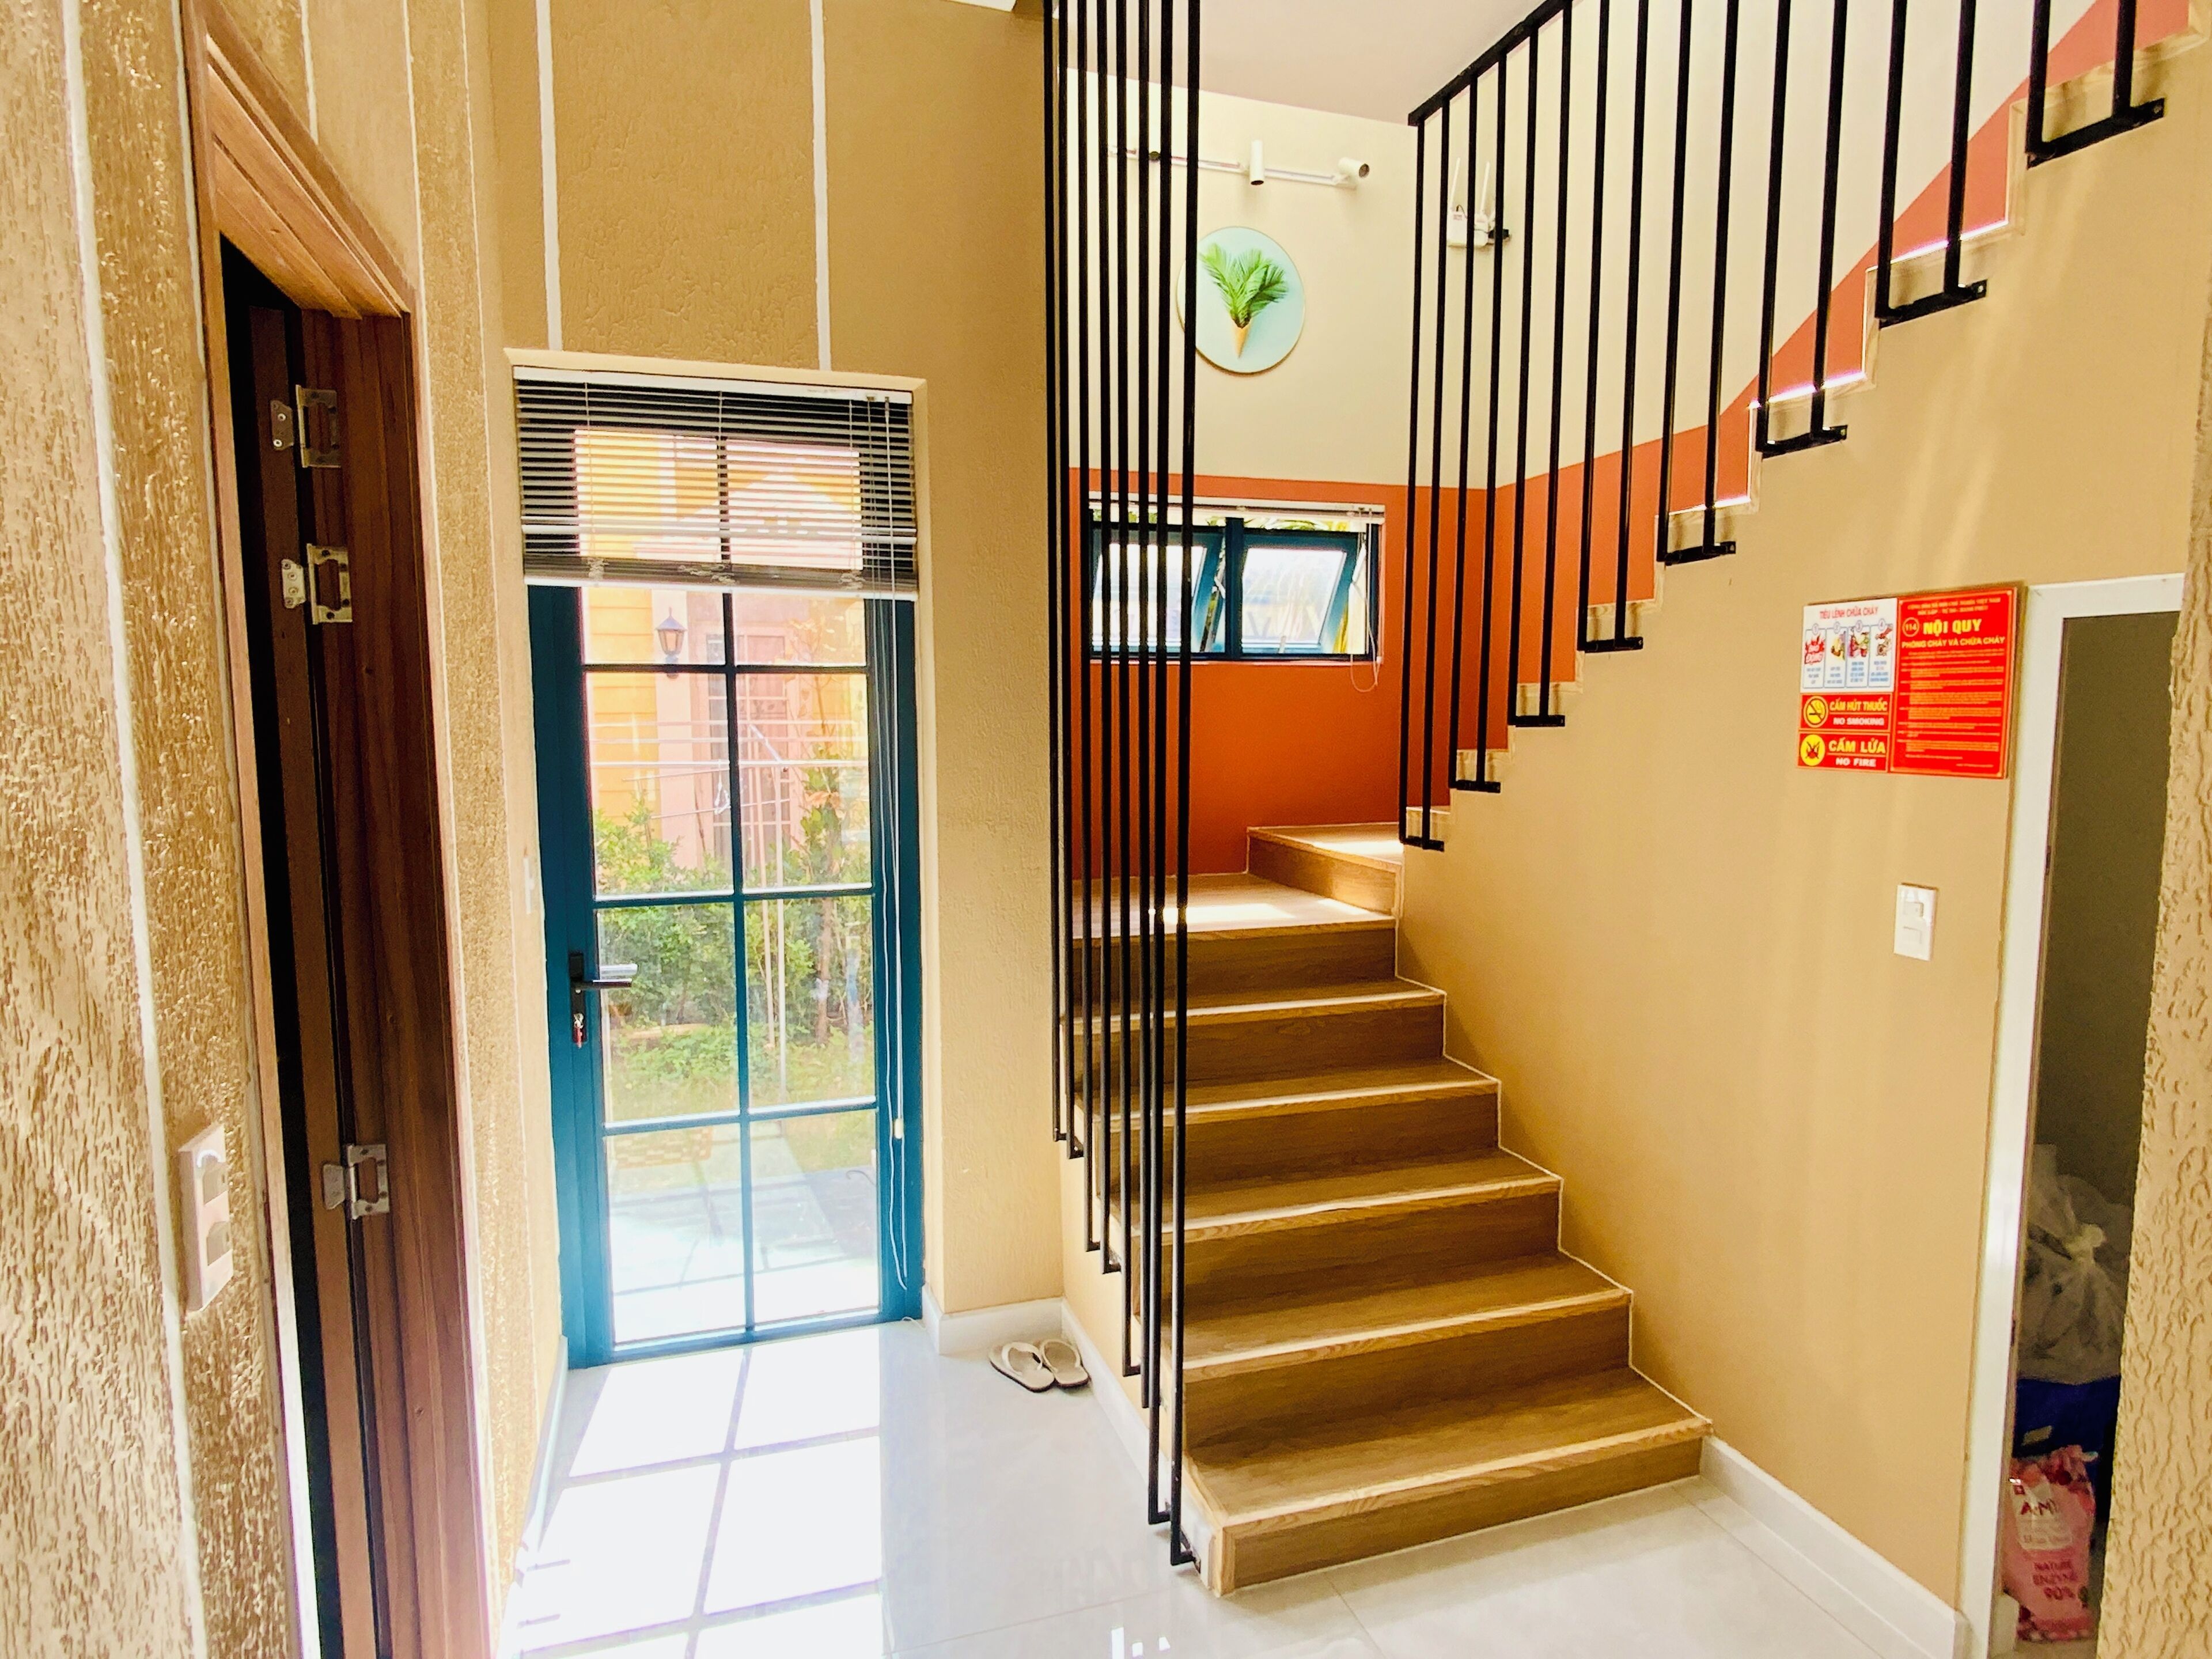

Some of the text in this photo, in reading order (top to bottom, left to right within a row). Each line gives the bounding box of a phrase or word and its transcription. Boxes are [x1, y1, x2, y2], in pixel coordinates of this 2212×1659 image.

[1906, 623, 1917, 631] 114
[1923, 619, 1982, 637] NỘI QUY
[1902, 635, 2005, 648] PHÒNG CHÁY VÀ CHỮA CHÁY
[1830, 698, 1846, 711] CẤM
[1847, 698, 1862, 711] HÚT
[1863, 697, 1888, 711] THUỐC
[1846, 717, 1885, 726] SMOKING
[1828, 737, 1856, 752] CẤM
[1860, 738, 1886, 753] LỬA
[1835, 757, 1877, 767] NO FIRE
